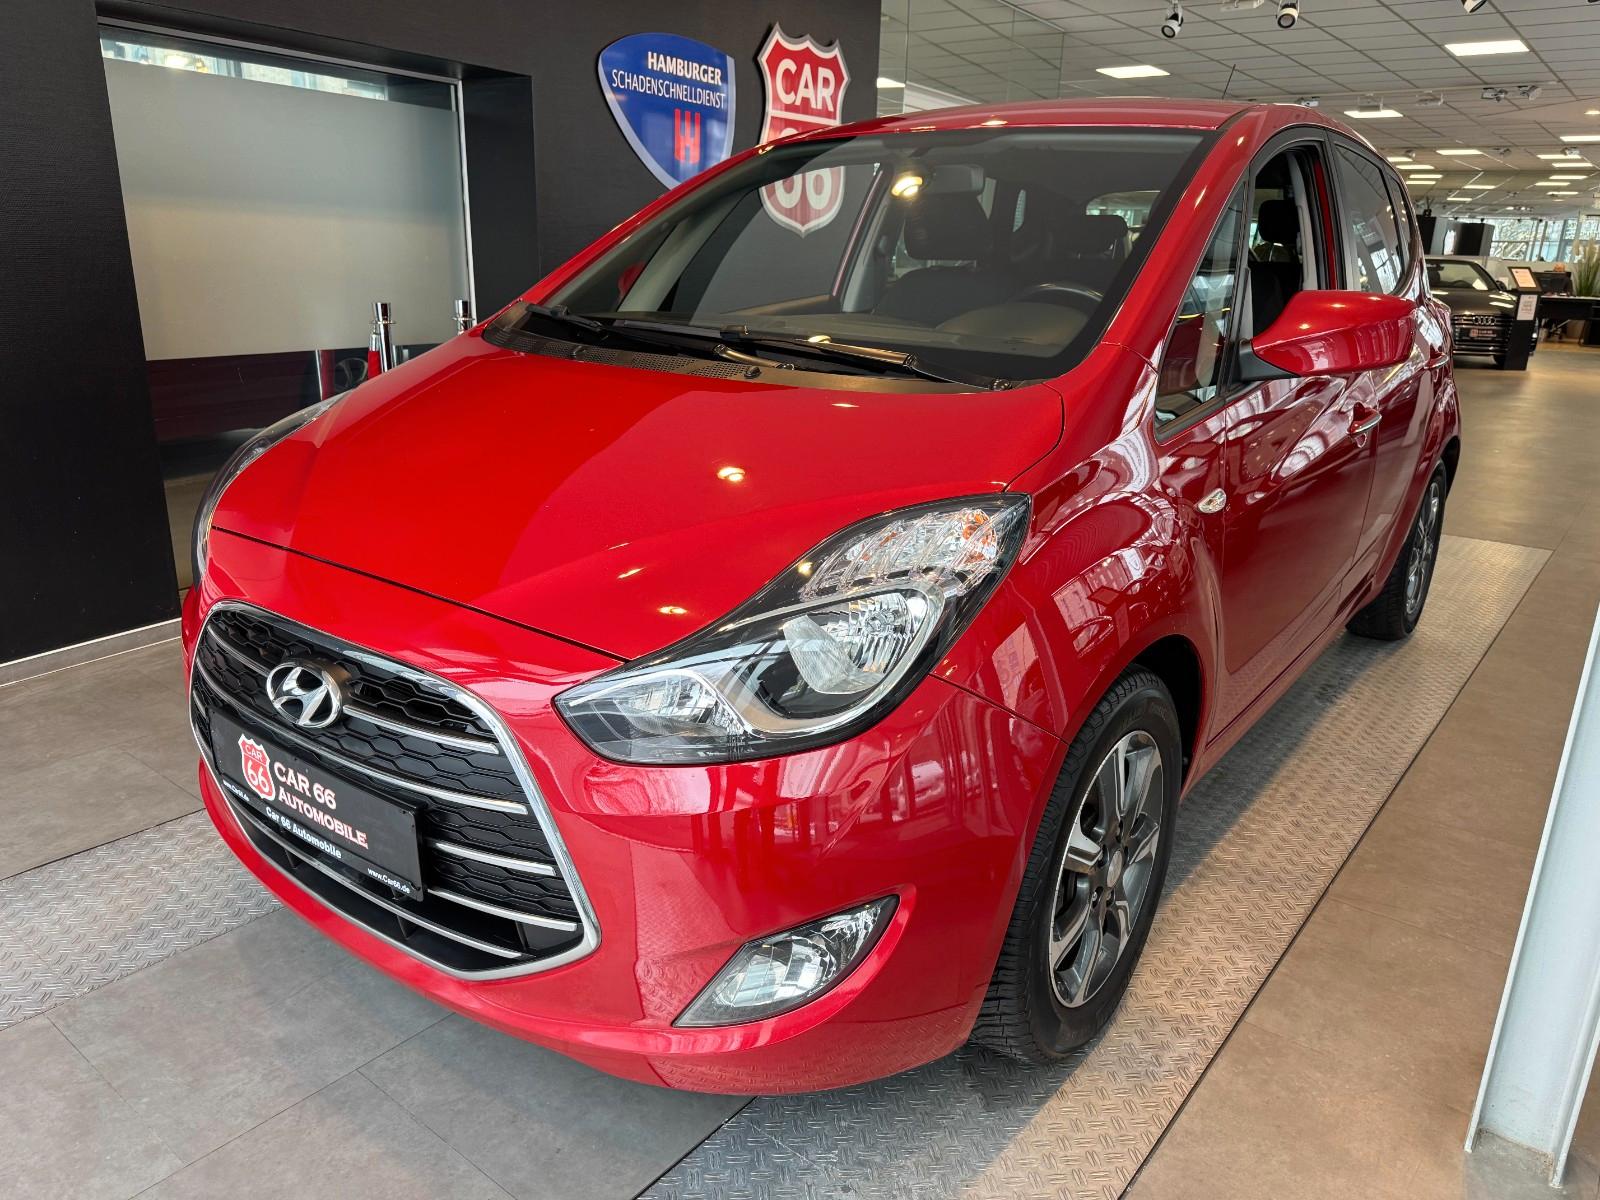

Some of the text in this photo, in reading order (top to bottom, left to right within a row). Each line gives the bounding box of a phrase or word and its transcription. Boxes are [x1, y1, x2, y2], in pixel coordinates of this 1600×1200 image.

[647, 51, 722, 86] HAMBURGER
[775, 58, 835, 112] CAR
[611, 69, 727, 109] SCHADENSCHNELLDIENST
[244, 744, 263, 763] CAR
[247, 761, 270, 794] 66
[273, 761, 337, 810] CAR 66
[265, 806, 342, 859] Car 66 Automobile
[277, 787, 369, 850] AUTOMOBILE
[366, 867, 411, 894] www.Car66.de
